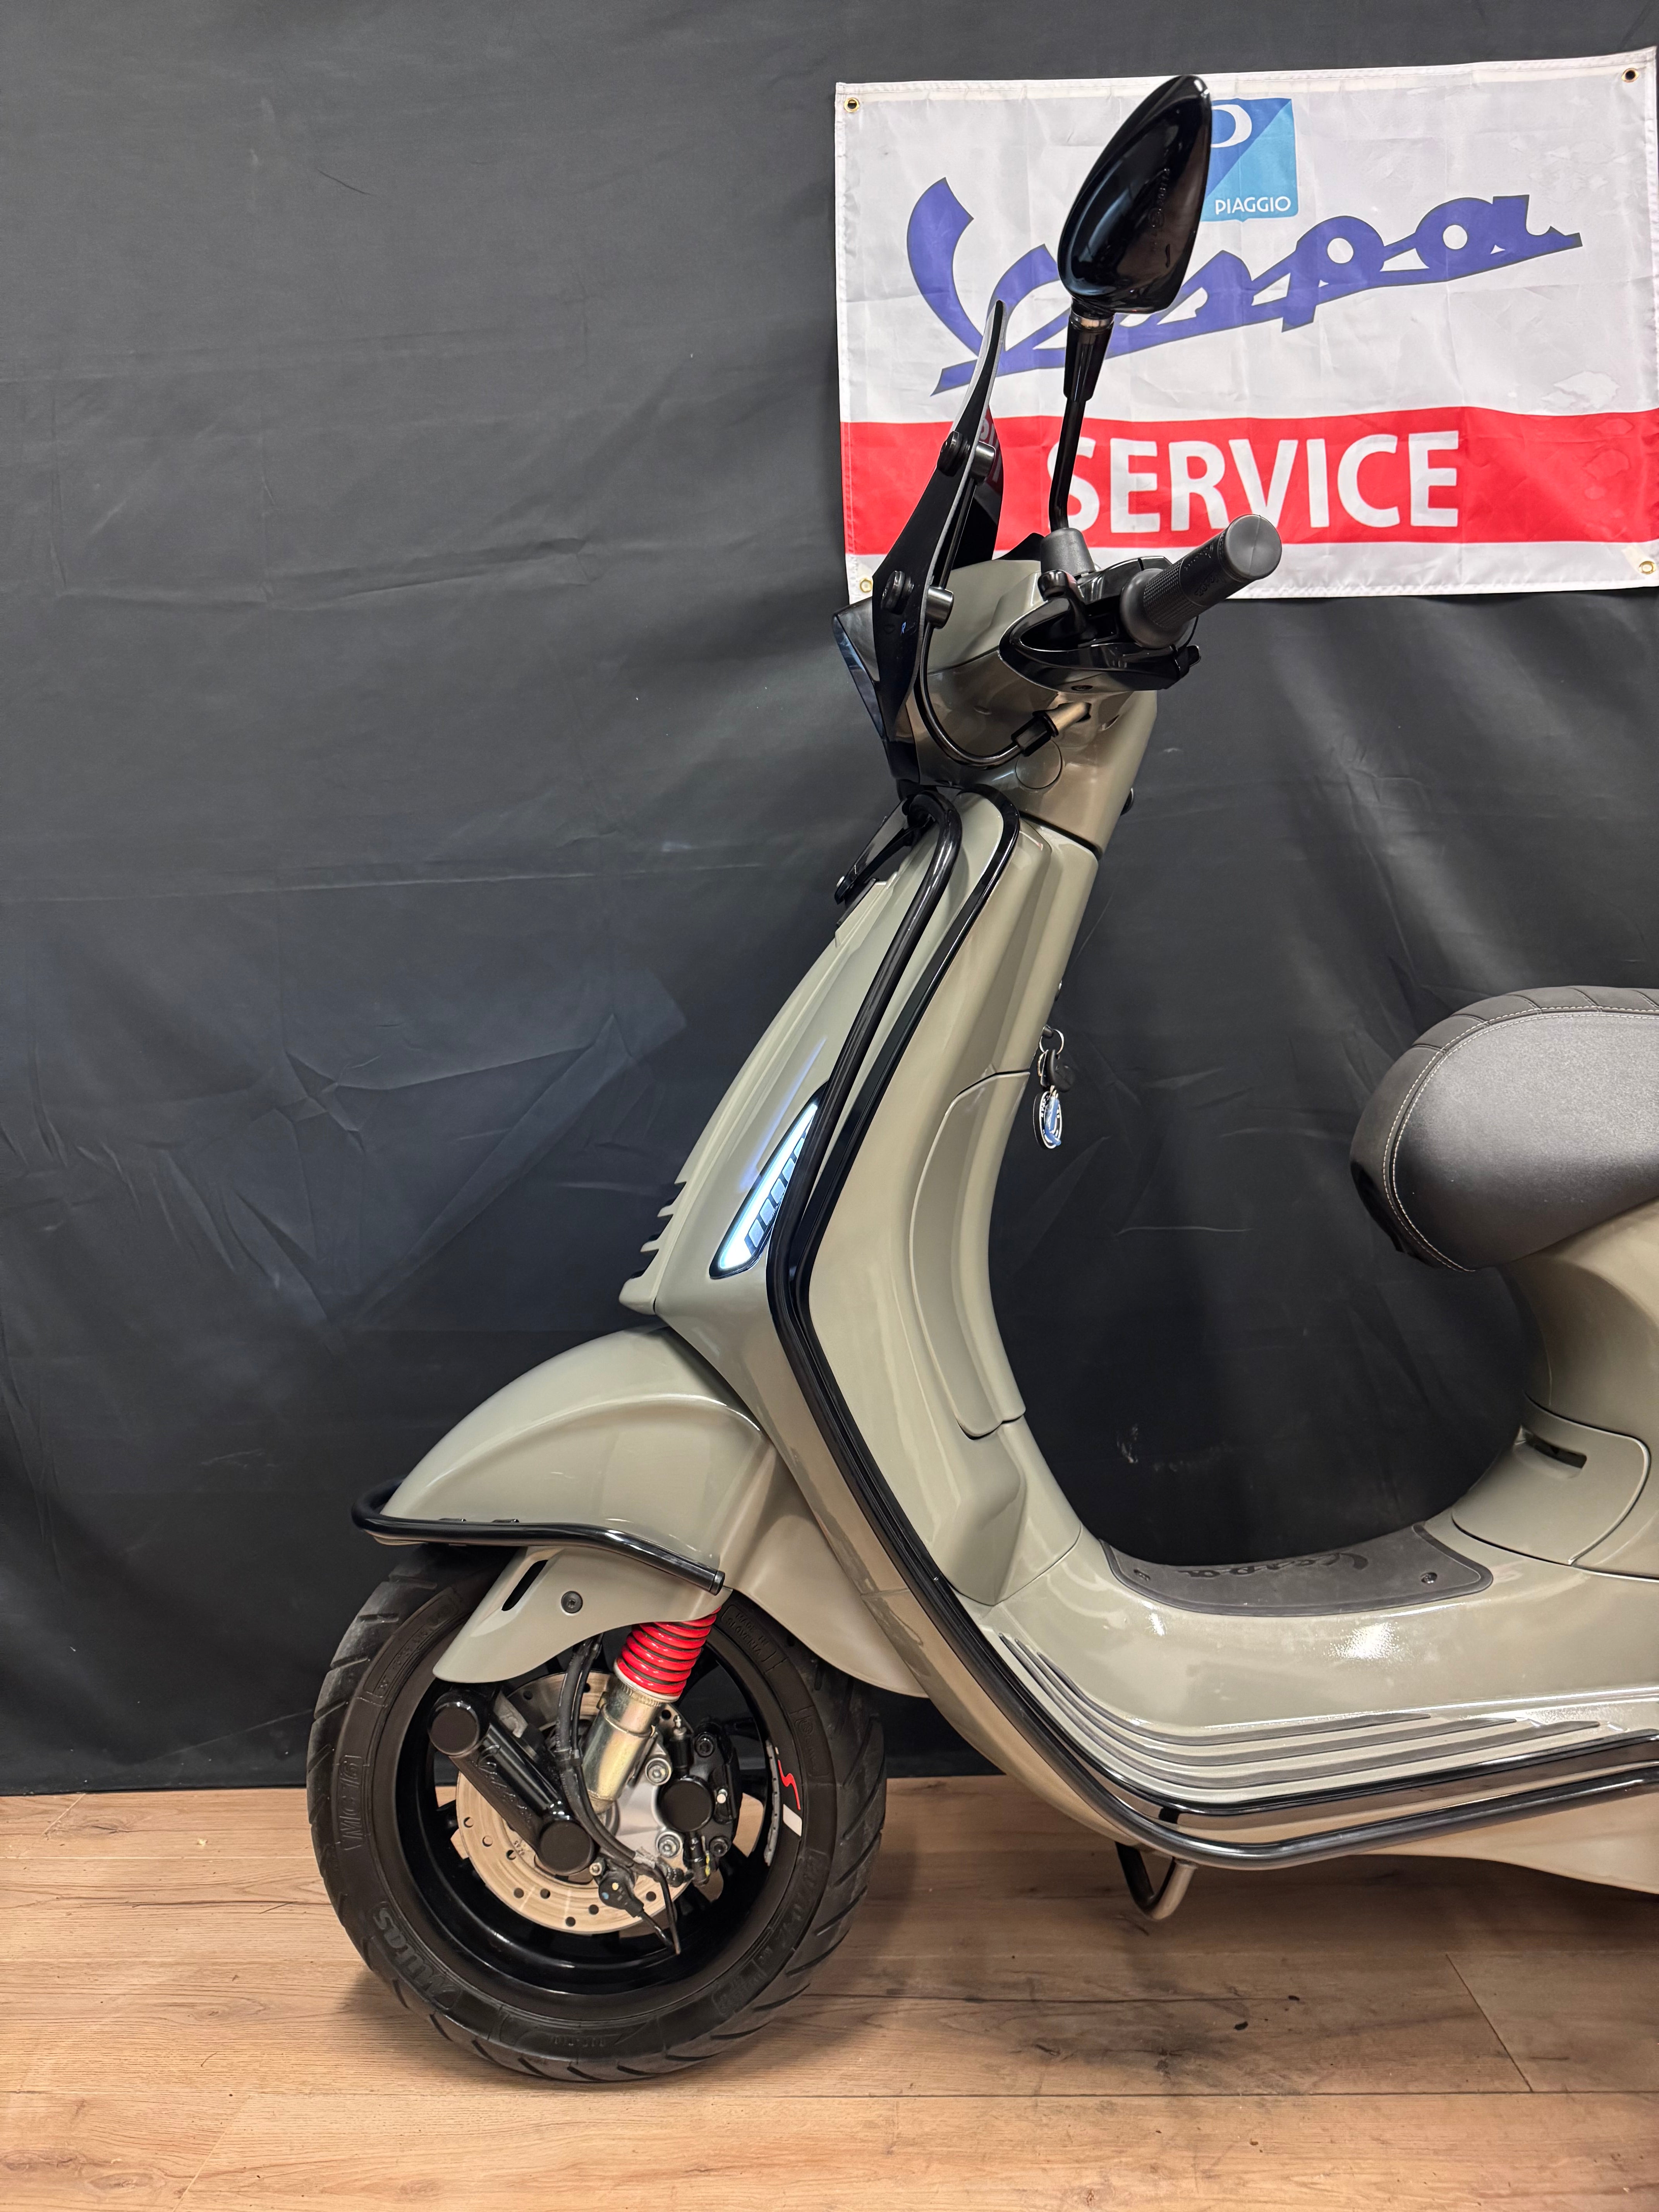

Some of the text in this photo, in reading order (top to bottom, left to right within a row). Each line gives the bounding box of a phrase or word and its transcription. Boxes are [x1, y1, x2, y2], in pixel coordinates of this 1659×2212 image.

[1215, 196, 1291, 215] PIAGGIO
[1047, 430, 1460, 533] SERVICE
[374, 1908, 456, 1995] Mitas
